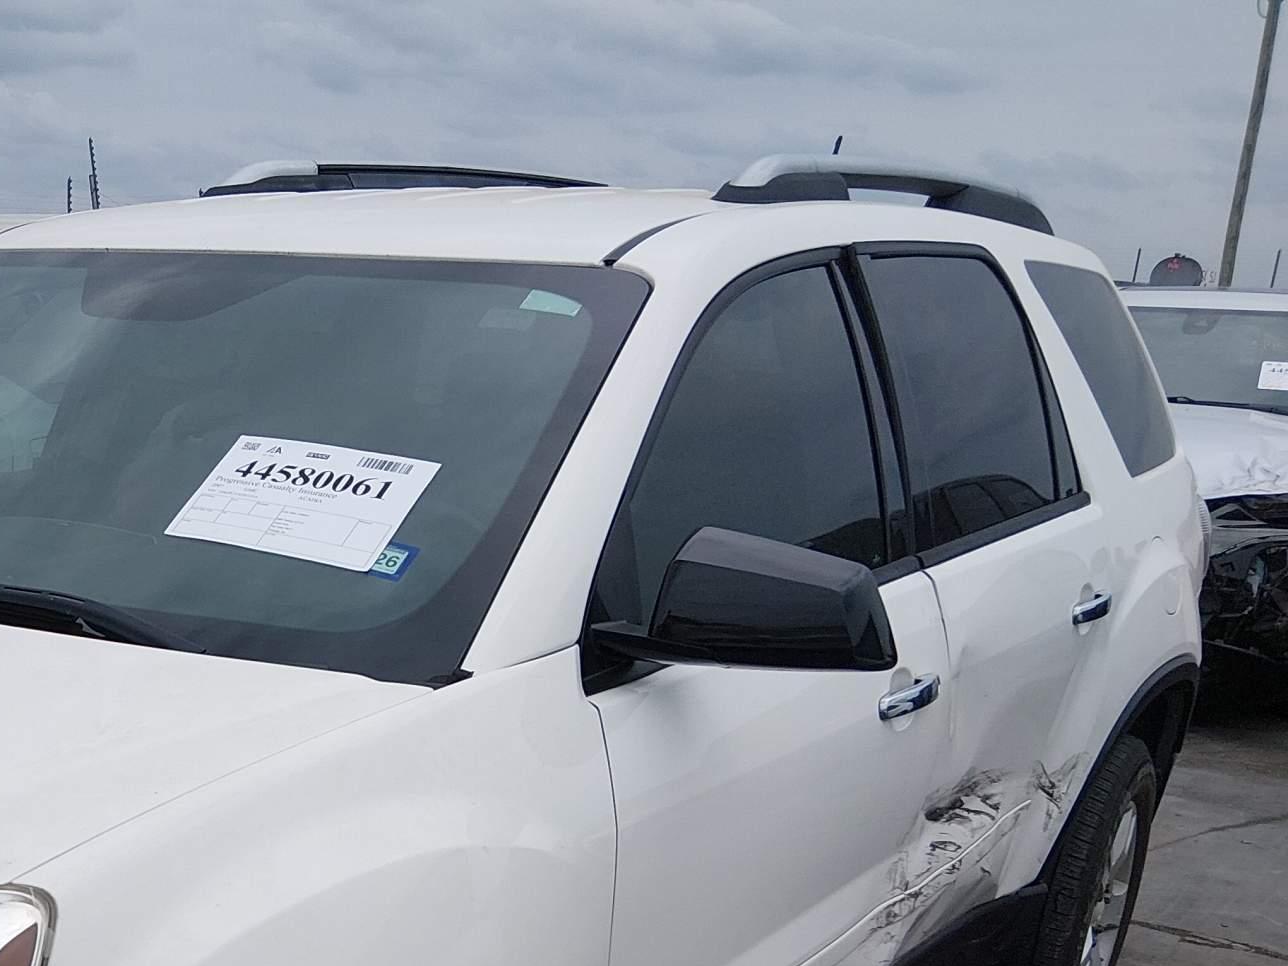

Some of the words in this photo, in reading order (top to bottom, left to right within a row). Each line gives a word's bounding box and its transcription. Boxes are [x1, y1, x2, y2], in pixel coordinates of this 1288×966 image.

[215, 475, 260, 487] Progressive
[262, 481, 297, 494] Casualty
[298, 487, 338, 499] Insurance
[235, 460, 393, 500] 44580061
[376, 552, 401, 568] 26
